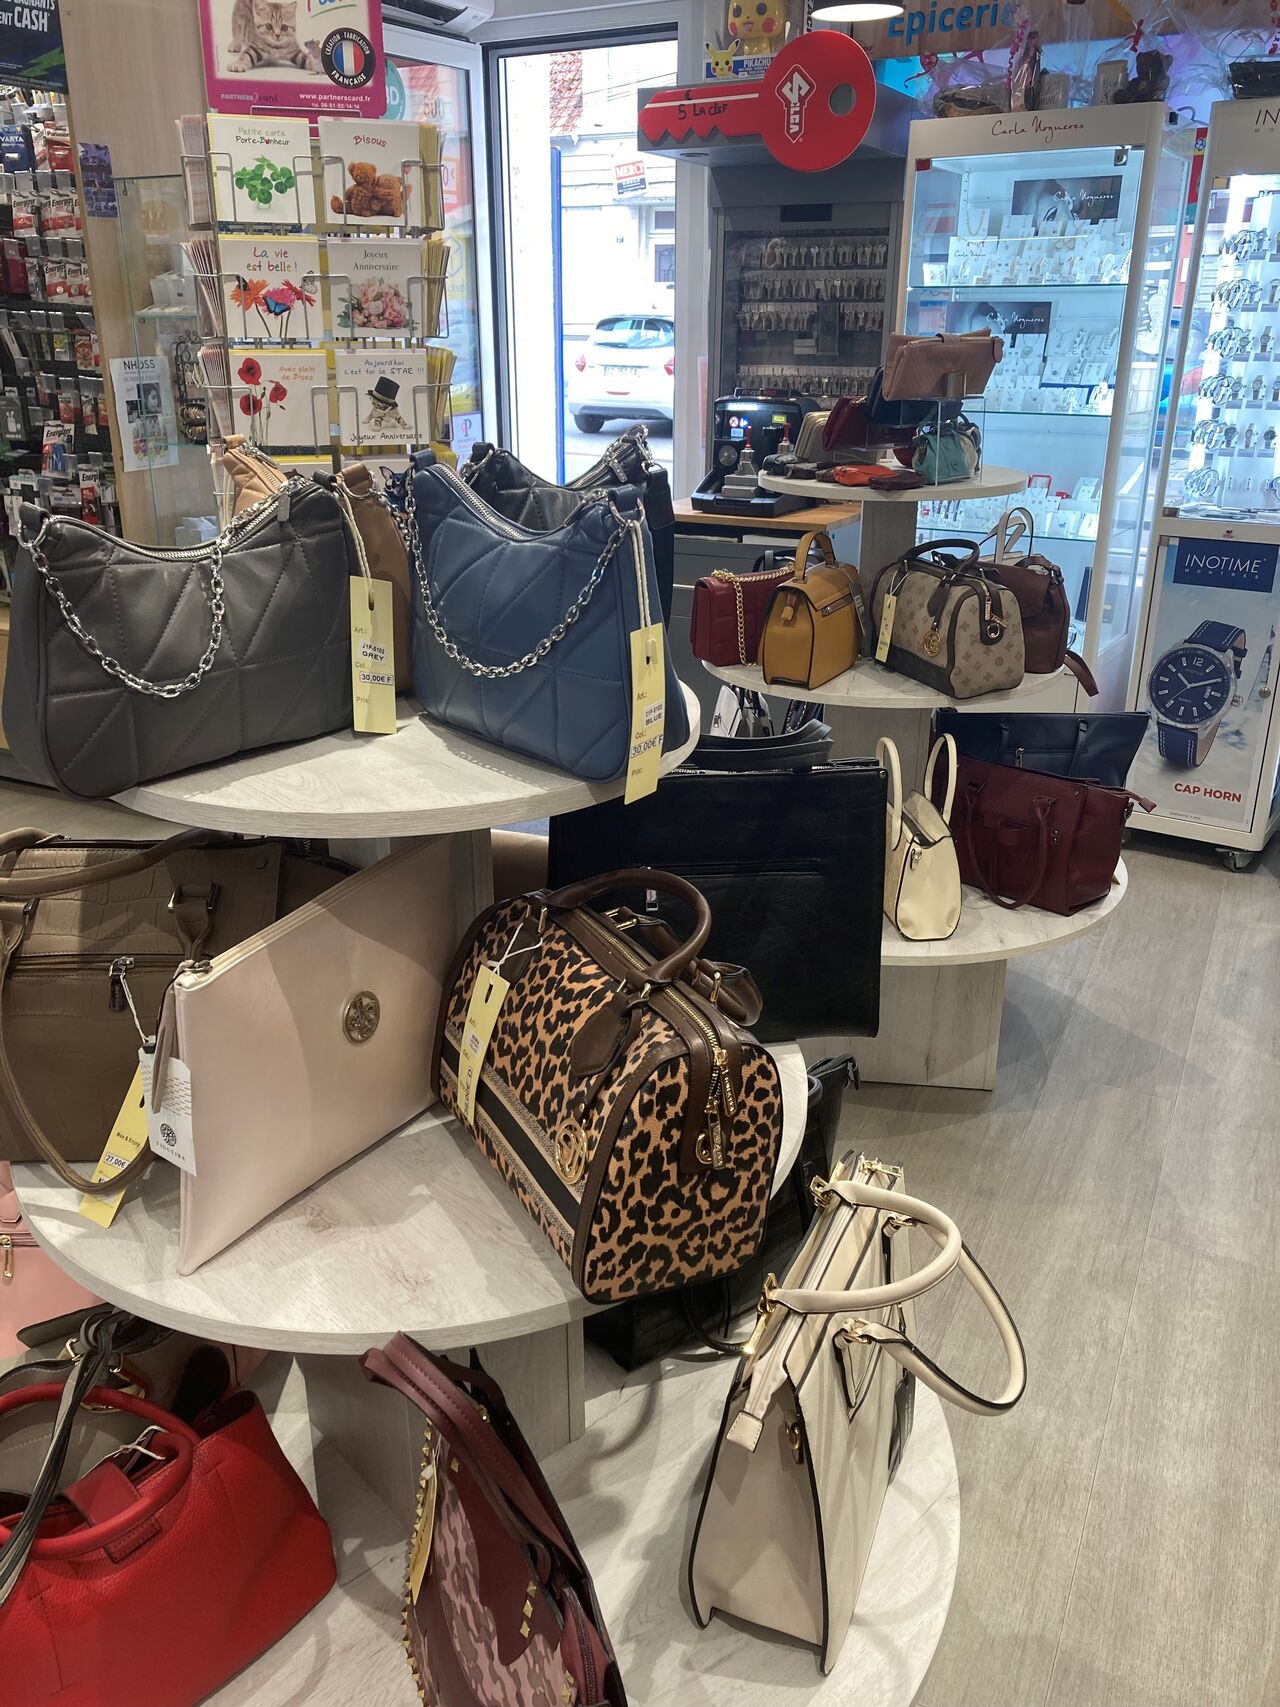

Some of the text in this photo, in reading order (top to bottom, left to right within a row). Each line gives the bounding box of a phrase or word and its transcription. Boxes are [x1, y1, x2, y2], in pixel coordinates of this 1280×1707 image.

[343, 31, 371, 55] FABRICATION
[743, 58, 771, 68] PIKACHU
[331, 70, 367, 87] FRANÇAISE
[299, 93, 371, 103] www.partnerscard.fr
[781, 71, 811, 134] SILCA
[678, 103, 688, 120] 5
[238, 127, 263, 136] Petite
[992, 120, 1028, 137] Carla
[353, 134, 387, 148] Bisous
[252, 246, 289, 259] La vie
[363, 249, 388, 260] Joyeux
[246, 263, 262, 272] est
[267, 261, 292, 273] belle
[352, 262, 399, 272] Anniversaire
[278, 365, 297, 373] Avec
[343, 367, 361, 375] c'est
[378, 367, 387, 375] la
[389, 367, 414, 375] STAR
[46, 427, 72, 438] Energizer
[1185, 553, 1262, 573] INOTIME
[361, 650, 384, 661] GREY
[1192, 656, 1204, 667] 12
[645, 712, 662, 726] BLUE
[1174, 782, 1242, 803] CAP HORN
[116, 1131, 126, 1140] Max
[105, 1154, 128, 1169] 27,00€
